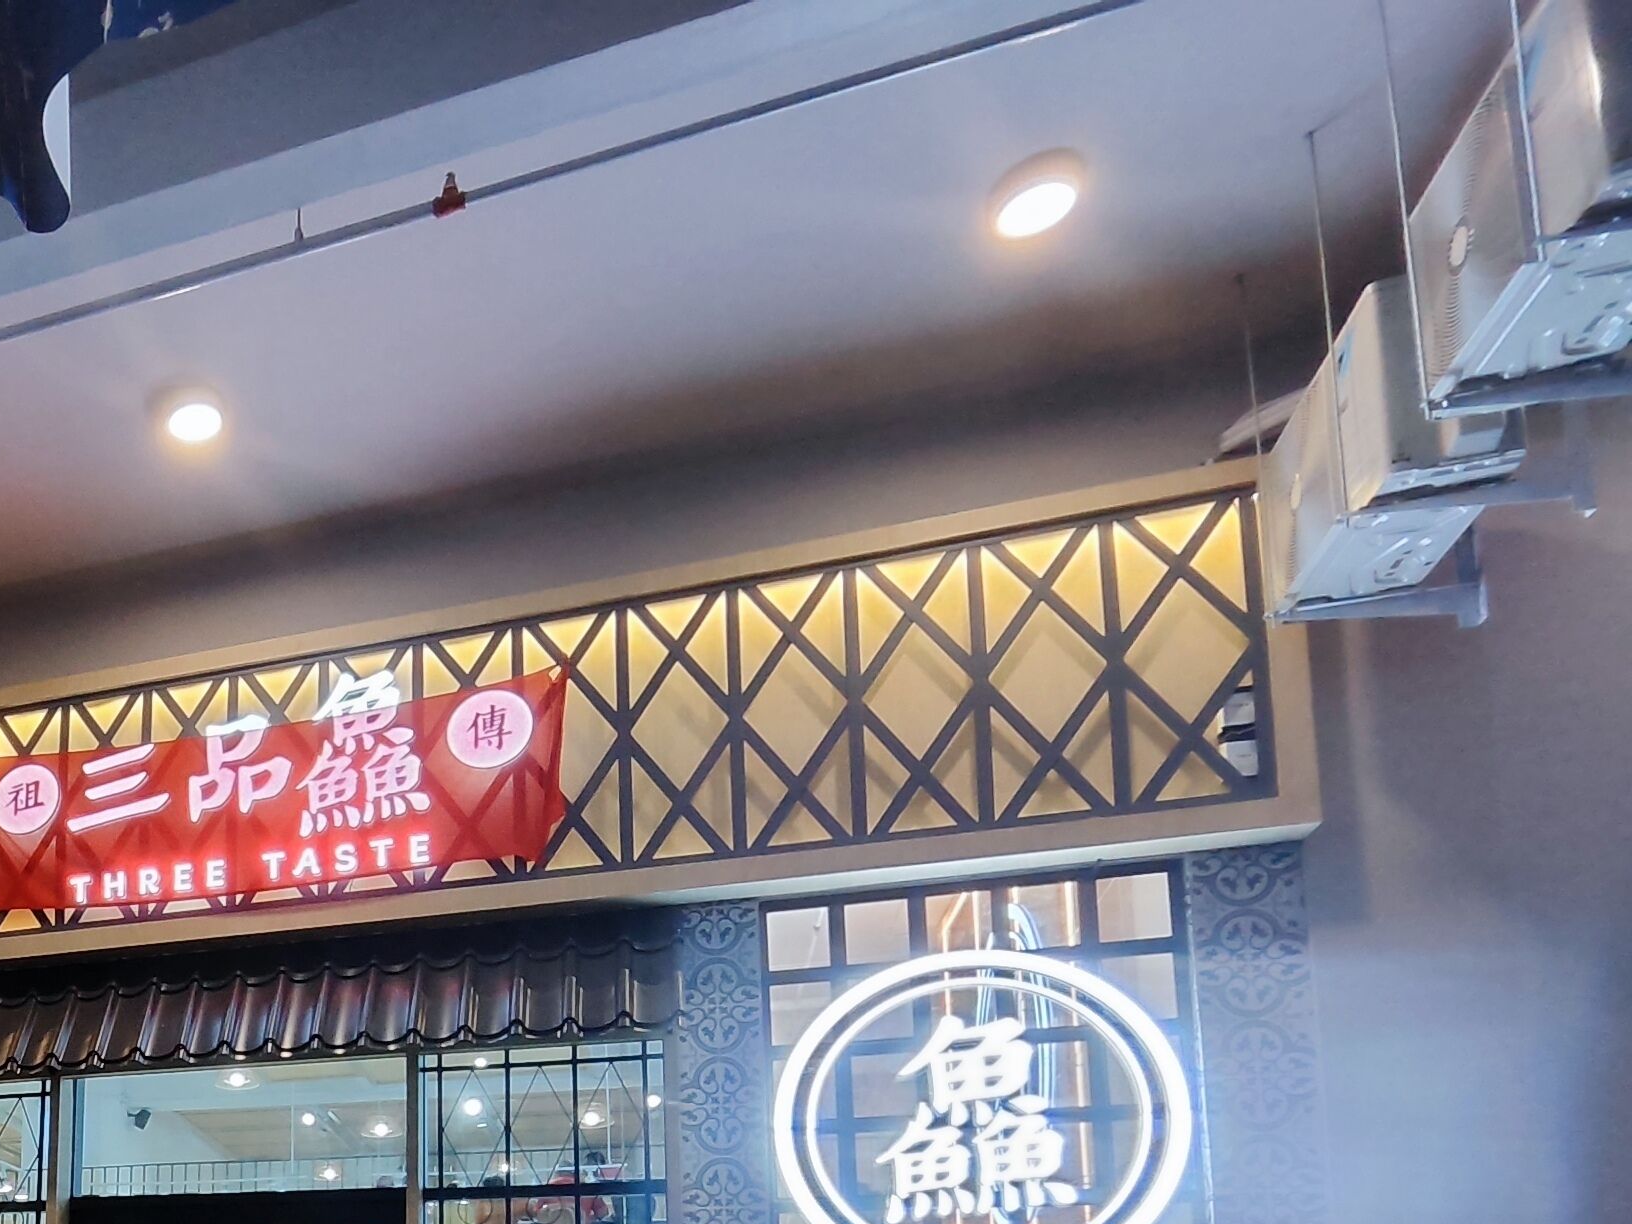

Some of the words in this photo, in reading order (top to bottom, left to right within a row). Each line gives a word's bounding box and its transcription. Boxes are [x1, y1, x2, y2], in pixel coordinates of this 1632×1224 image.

[6, 777, 46, 817] 祖
[467, 702, 513, 754] 傳
[69, 858, 227, 903] THREE
[262, 833, 431, 881] TASTE
